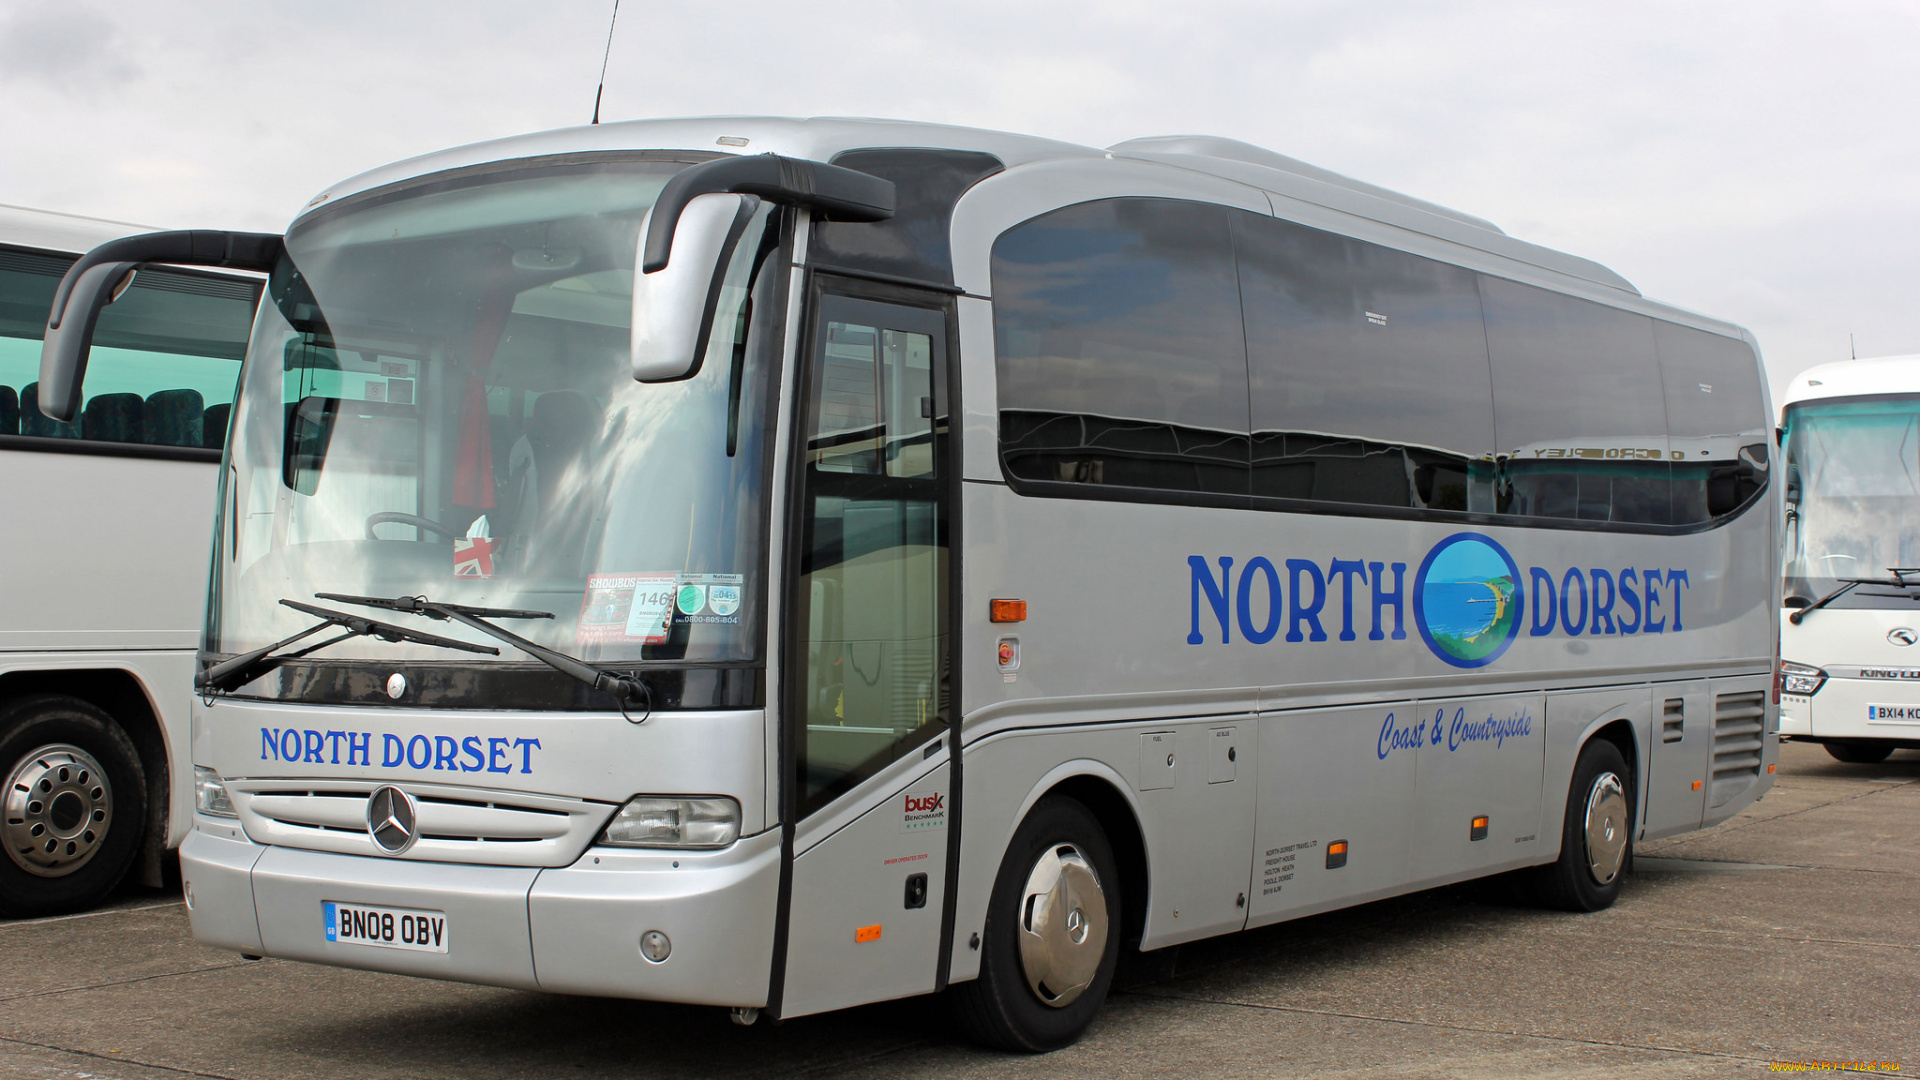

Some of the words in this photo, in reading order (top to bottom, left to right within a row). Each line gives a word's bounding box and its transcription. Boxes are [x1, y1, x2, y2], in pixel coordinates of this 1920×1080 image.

[589, 577, 636, 589] SHOWBUS
[639, 592, 669, 606] 146
[1187, 555, 1407, 645] NORTH
[1529, 566, 1690, 637] DORSET
[1860, 669, 1898, 678] KING
[1878, 707, 1905, 719] BX14
[1377, 712, 1426, 760] Coast
[1431, 708, 1444, 746] &
[1449, 705, 1532, 752] Countryside
[260, 728, 372, 766] NORTH
[382, 734, 542, 774] DORSET
[904, 792, 945, 813] busk
[1265, 847, 1279, 856] NORTH
[1280, 844, 1295, 854] DORSET
[1296, 841, 1309, 850] TRAVEL
[1265, 857, 1282, 866] FREIGHT
[1282, 854, 1296, 862] HOUSE
[1278, 873, 1294, 882] DORSET
[327, 926, 335, 936] GB
[339, 908, 395, 942] BN08
[401, 915, 444, 946] OBV
